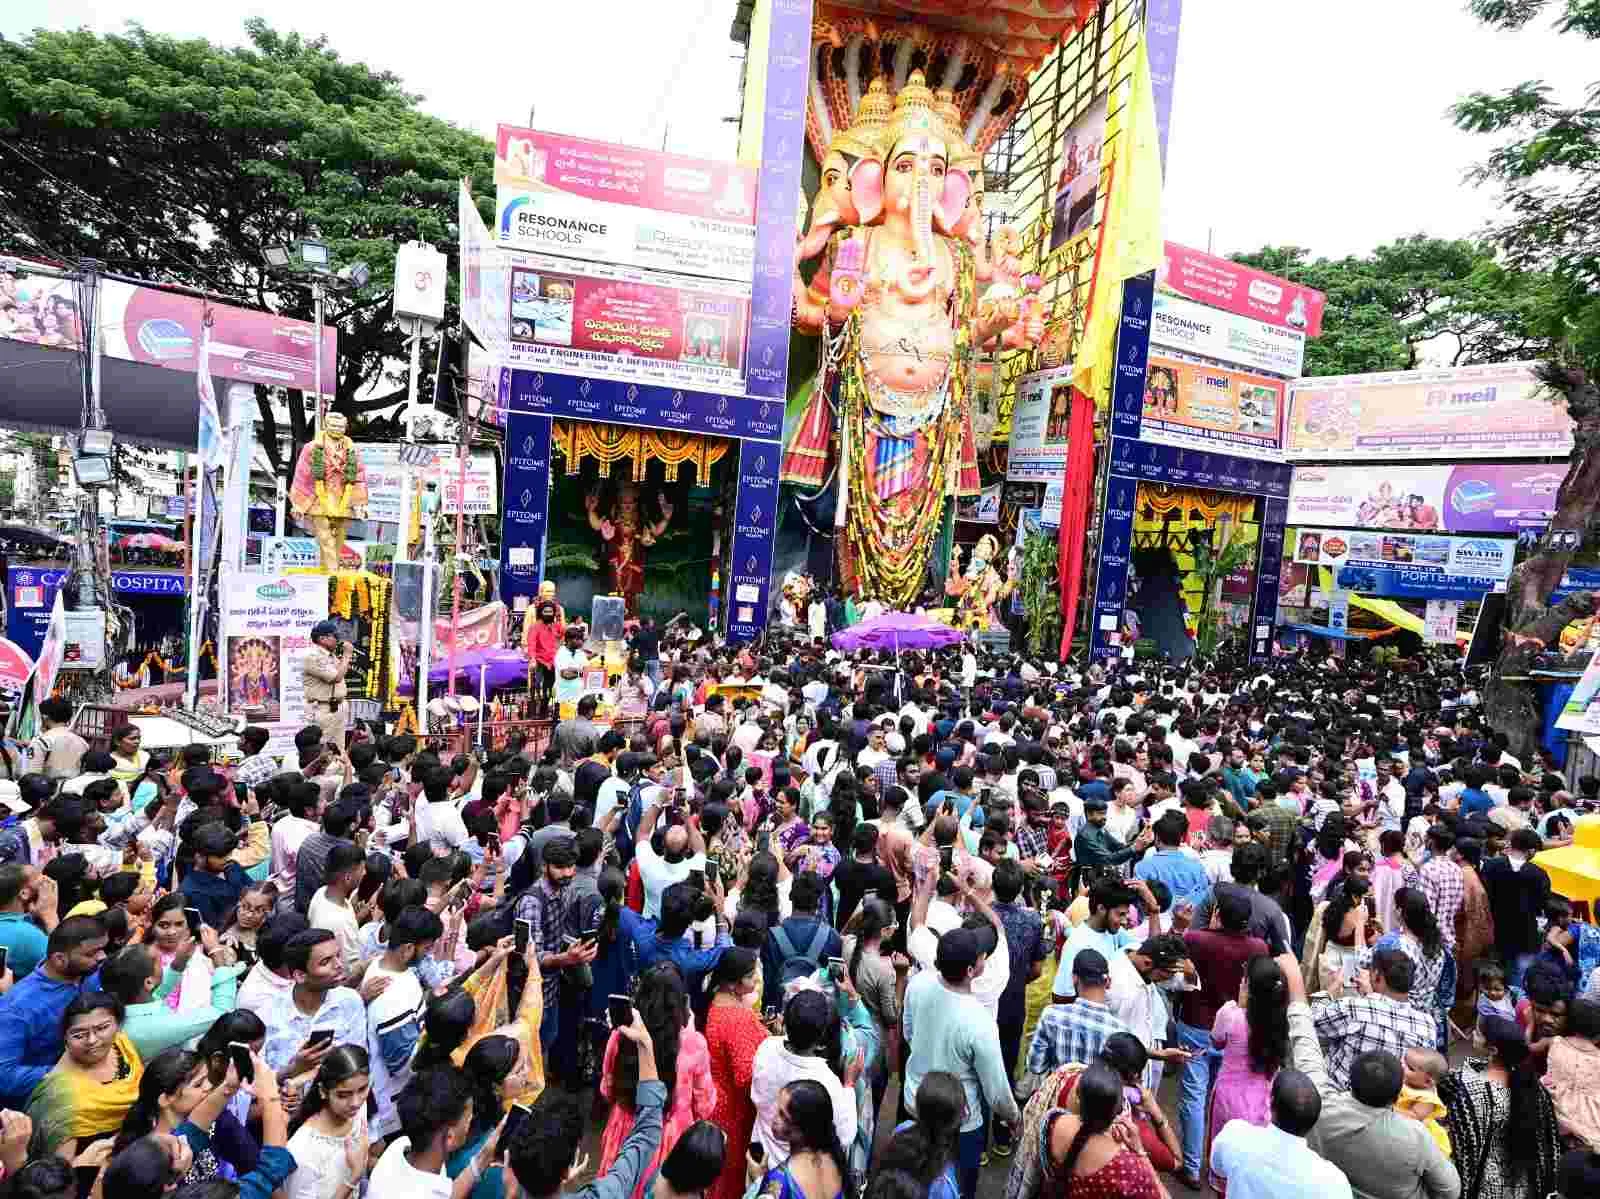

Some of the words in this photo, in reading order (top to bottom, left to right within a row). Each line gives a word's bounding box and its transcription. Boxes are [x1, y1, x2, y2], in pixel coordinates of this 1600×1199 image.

[518, 212, 608, 235] RESONANCE
[518, 226, 584, 245] SCHOOLS
[1155, 312, 1212, 335] RESONANCE
[512, 343, 547, 356] MEGHA
[550, 346, 614, 364] ENGINEERING
[1452, 387, 1496, 402] meil
[509, 457, 545, 468] EPITOME
[507, 511, 542, 521] EPITOME
[111, 575, 184, 591] OSPITA
[1399, 571, 1456, 584] PORTER
